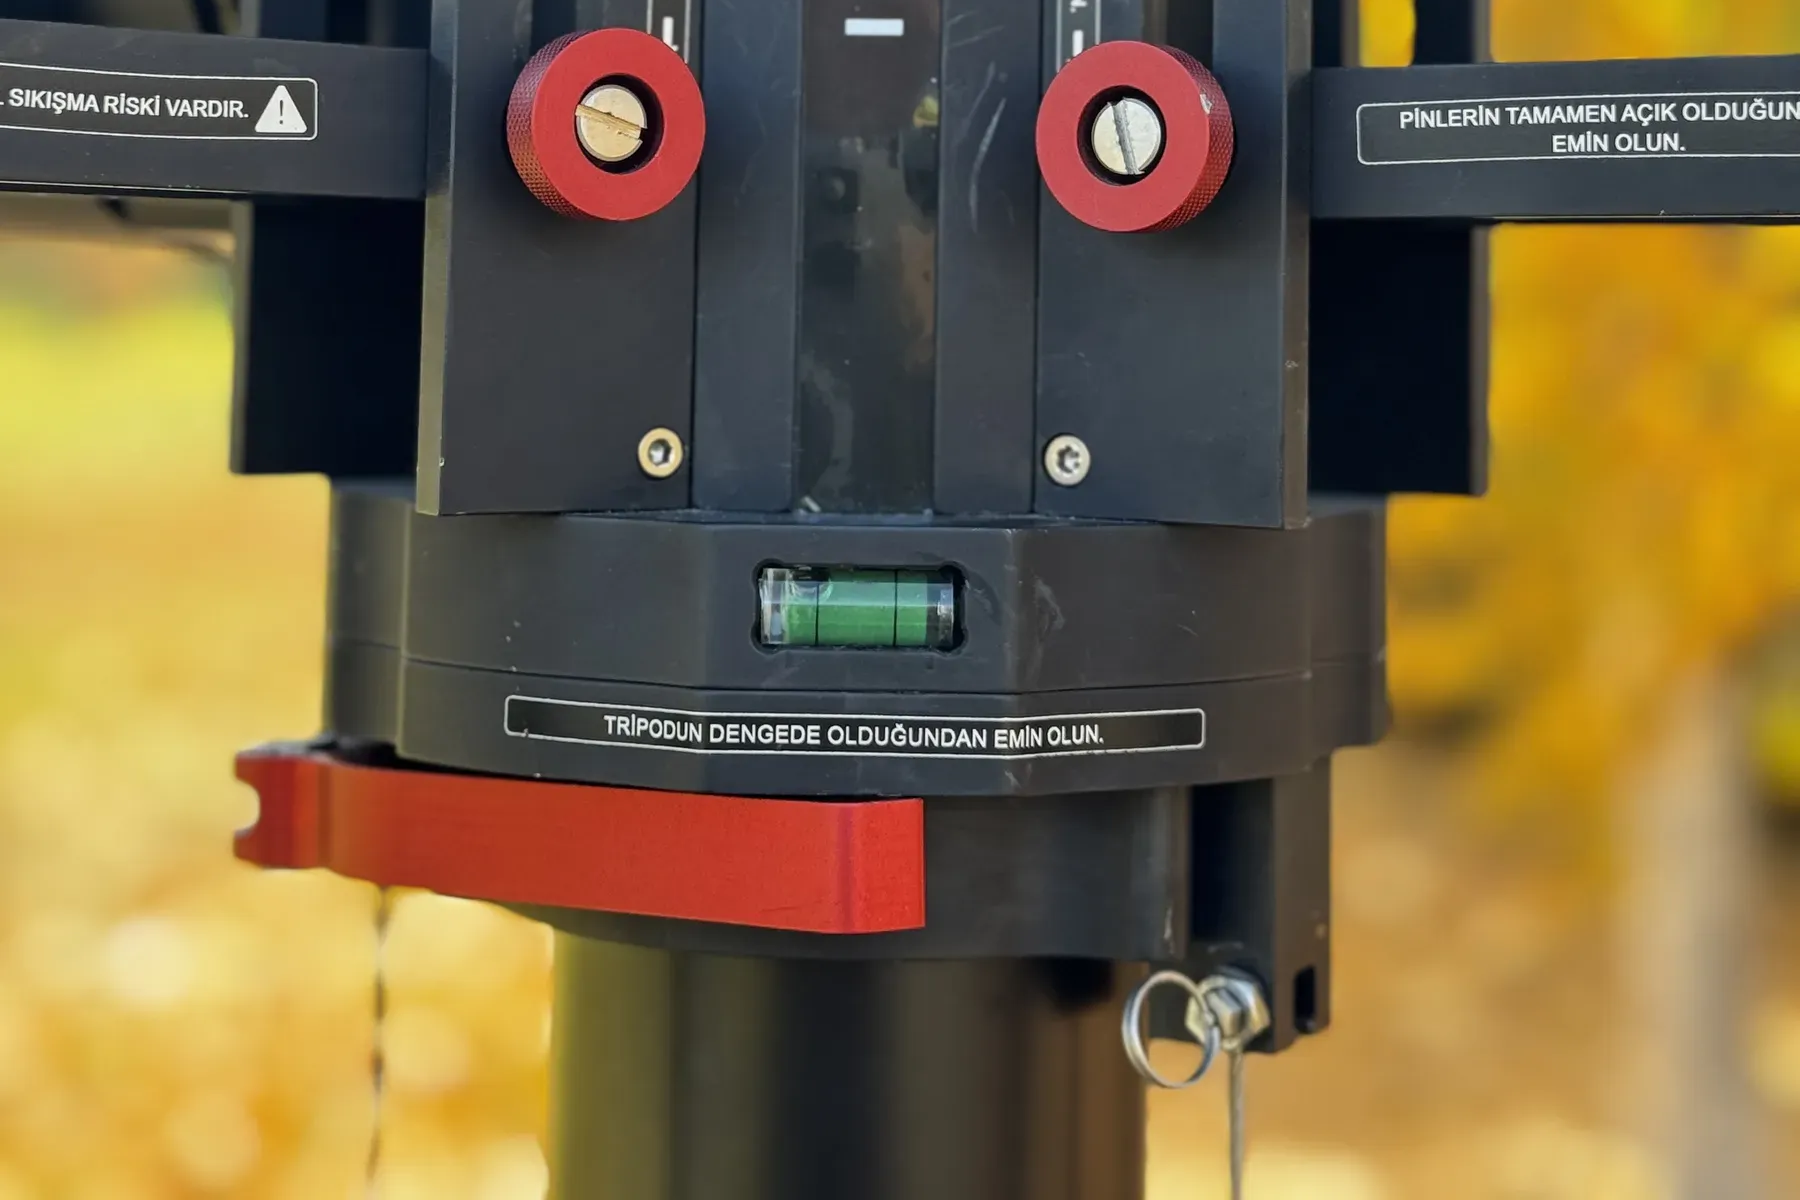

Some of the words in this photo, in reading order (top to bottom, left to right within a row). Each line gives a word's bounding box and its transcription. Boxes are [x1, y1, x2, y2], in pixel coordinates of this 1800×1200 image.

[8, 87, 99, 115] SIKIŞMA
[103, 92, 160, 117] RİSKİ
[164, 97, 250, 120] VARDIR.
[1400, 105, 1500, 129] PİNLERİN
[1504, 102, 1618, 126] TAMAMEN
[1620, 103, 1677, 125] AÇIK
[1681, 97, 1800, 122] OLDUĞUN
[1551, 131, 1610, 154] EMİN
[1614, 132, 1687, 153] OLUN.
[603, 714, 702, 743] TRİPODUN
[708, 723, 820, 747] DENGEDE
[826, 721, 987, 750] OLDUĞUNDAN
[993, 724, 1043, 750] EMİN
[1045, 723, 1105, 747] OLUN.
